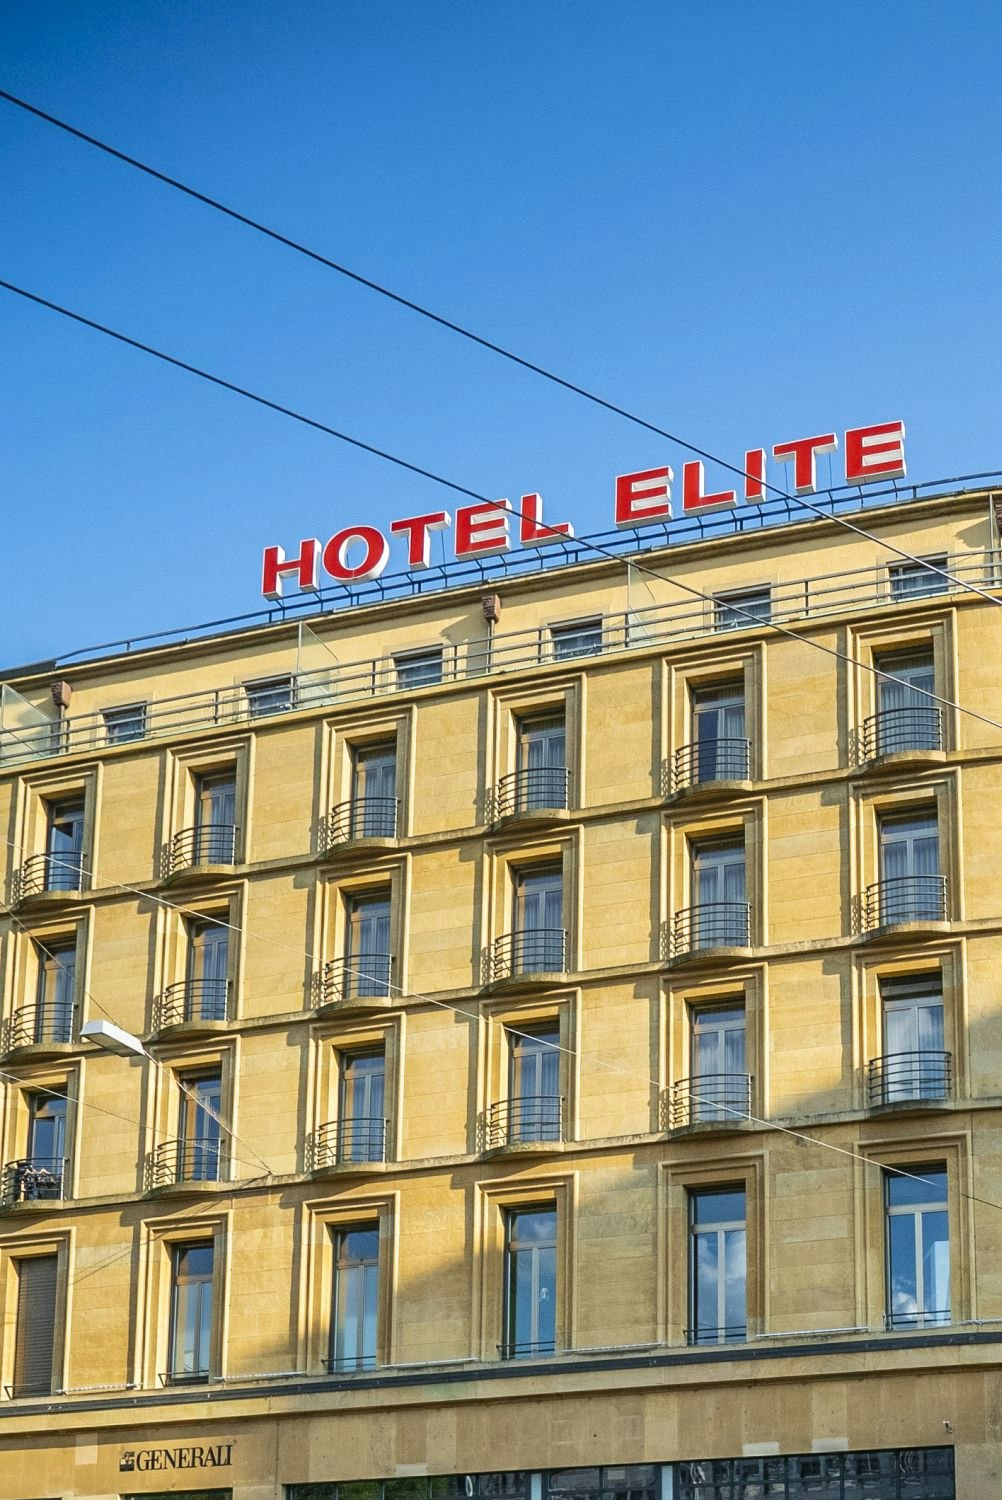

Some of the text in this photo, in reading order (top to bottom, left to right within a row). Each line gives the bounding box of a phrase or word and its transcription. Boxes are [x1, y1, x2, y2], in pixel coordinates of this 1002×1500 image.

[261, 420, 907, 600] HOTEL ELITE
[136, 1444, 233, 1472] GENERALI
